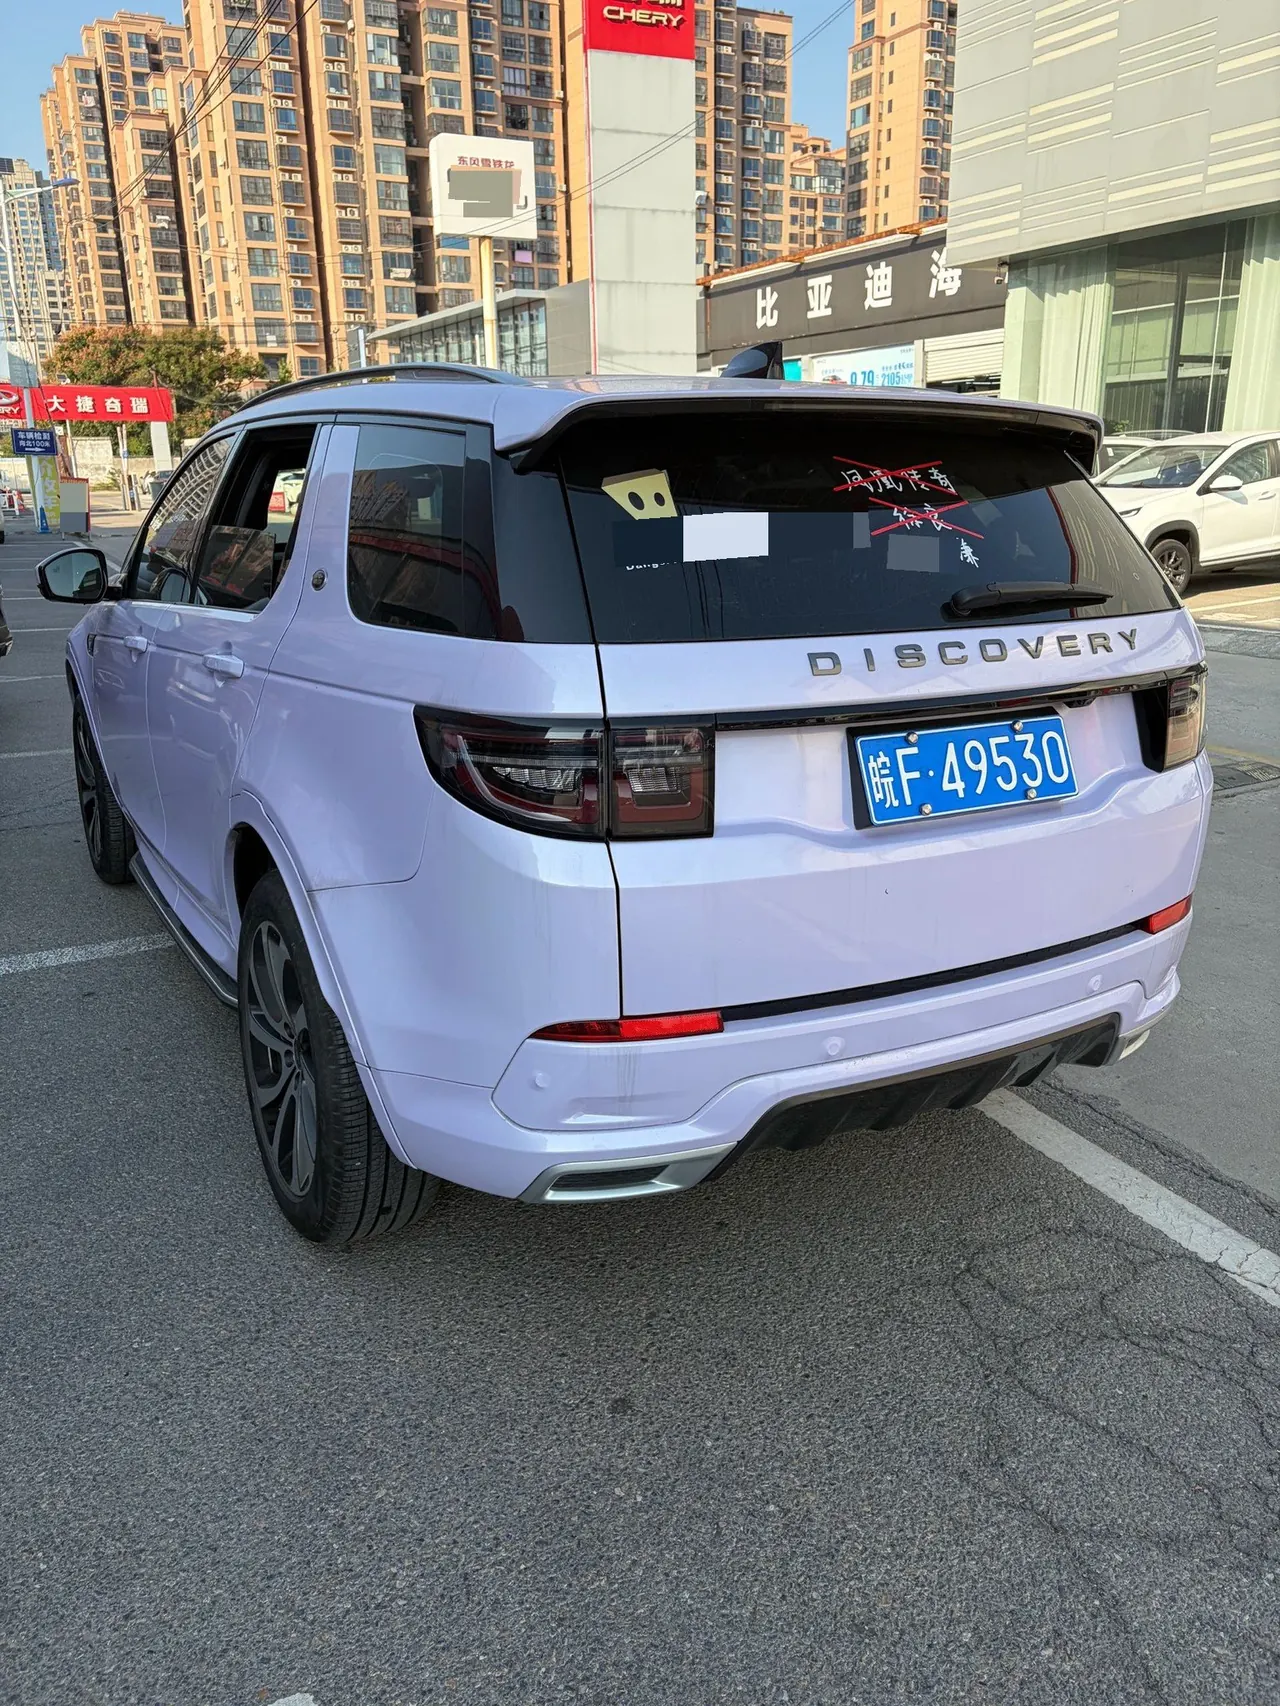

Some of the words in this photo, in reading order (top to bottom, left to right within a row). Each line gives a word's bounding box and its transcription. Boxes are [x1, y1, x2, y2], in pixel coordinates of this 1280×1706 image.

[603, 6, 683, 26] CHERY
[755, 247, 962, 329] 比亚迪海
[47, 395, 149, 414] 大捷奇瑞
[807, 628, 1138, 677] DISCOVERY
